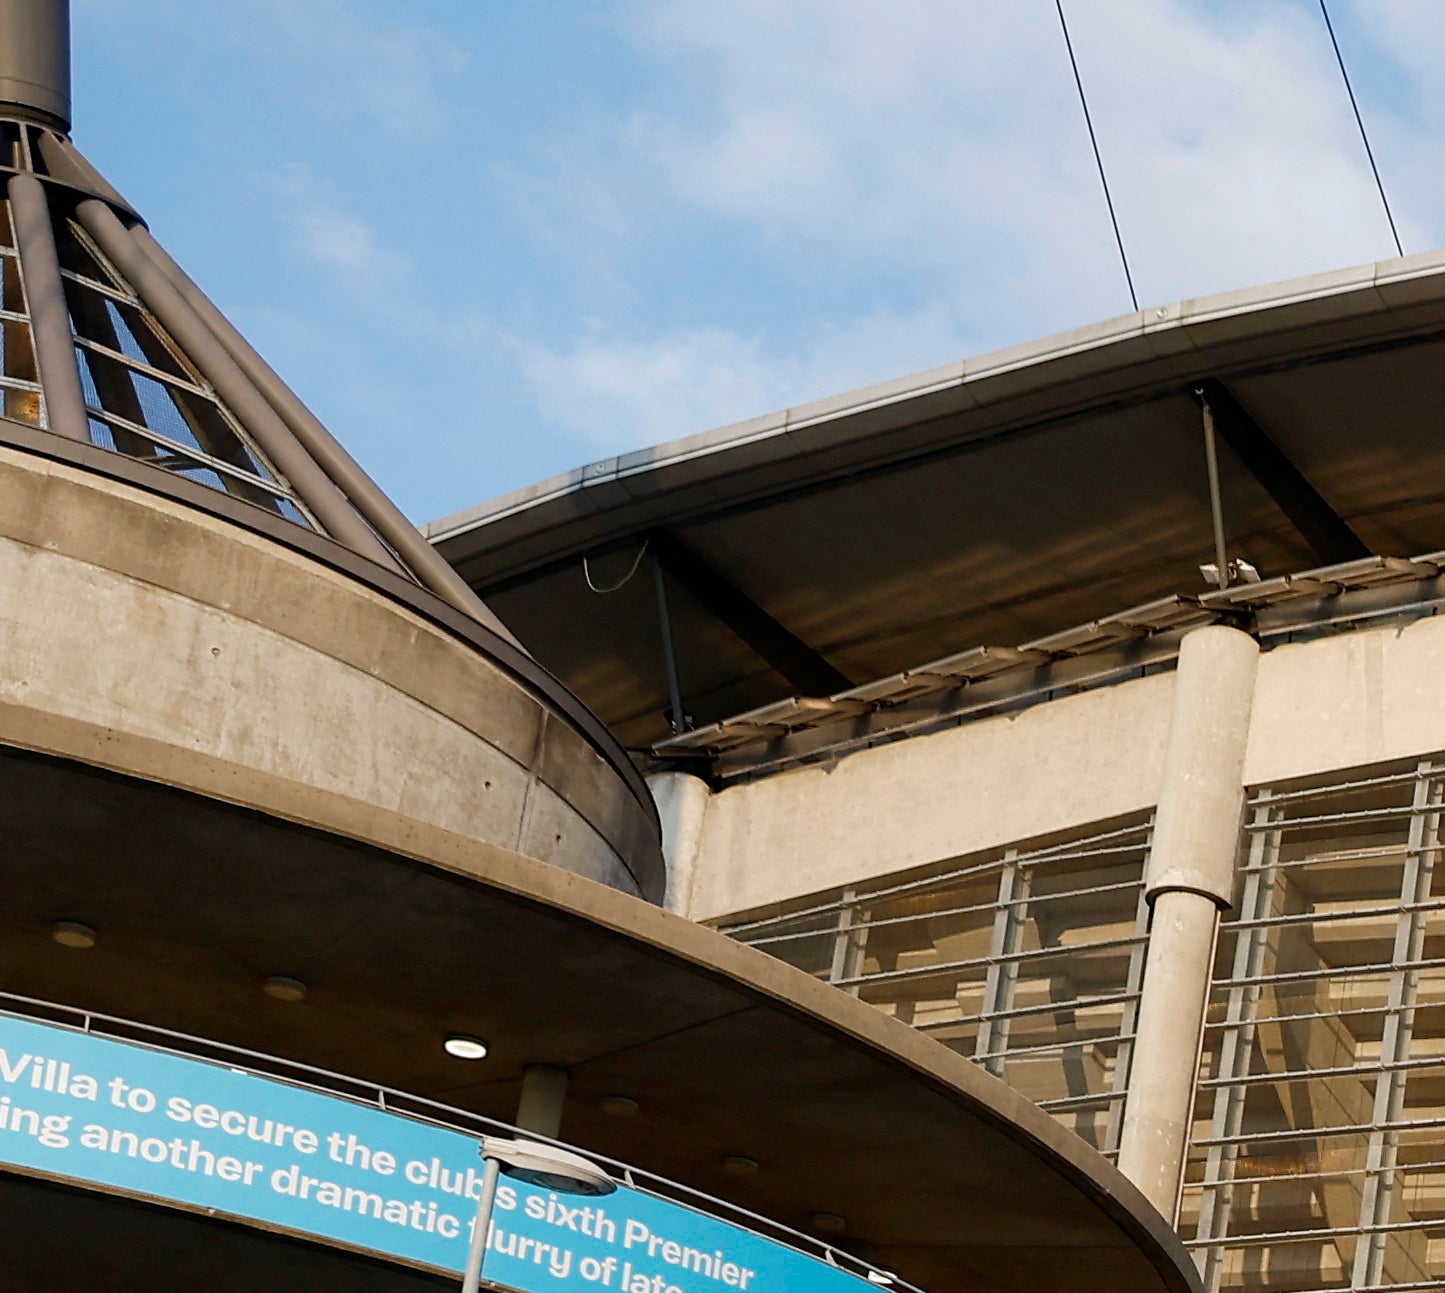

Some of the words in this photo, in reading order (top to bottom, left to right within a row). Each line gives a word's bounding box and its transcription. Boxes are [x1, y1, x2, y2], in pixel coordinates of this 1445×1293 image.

[0, 1048, 97, 1102] Villa
[108, 1077, 156, 1113] to
[166, 1096, 319, 1154] secure
[327, 1132, 397, 1175] the
[525, 1193, 616, 1243] sixth
[623, 1218, 755, 1290] Premier
[80, 1121, 264, 1185] another
[270, 1165, 460, 1238] dramatic
[579, 1255, 617, 1286] of
